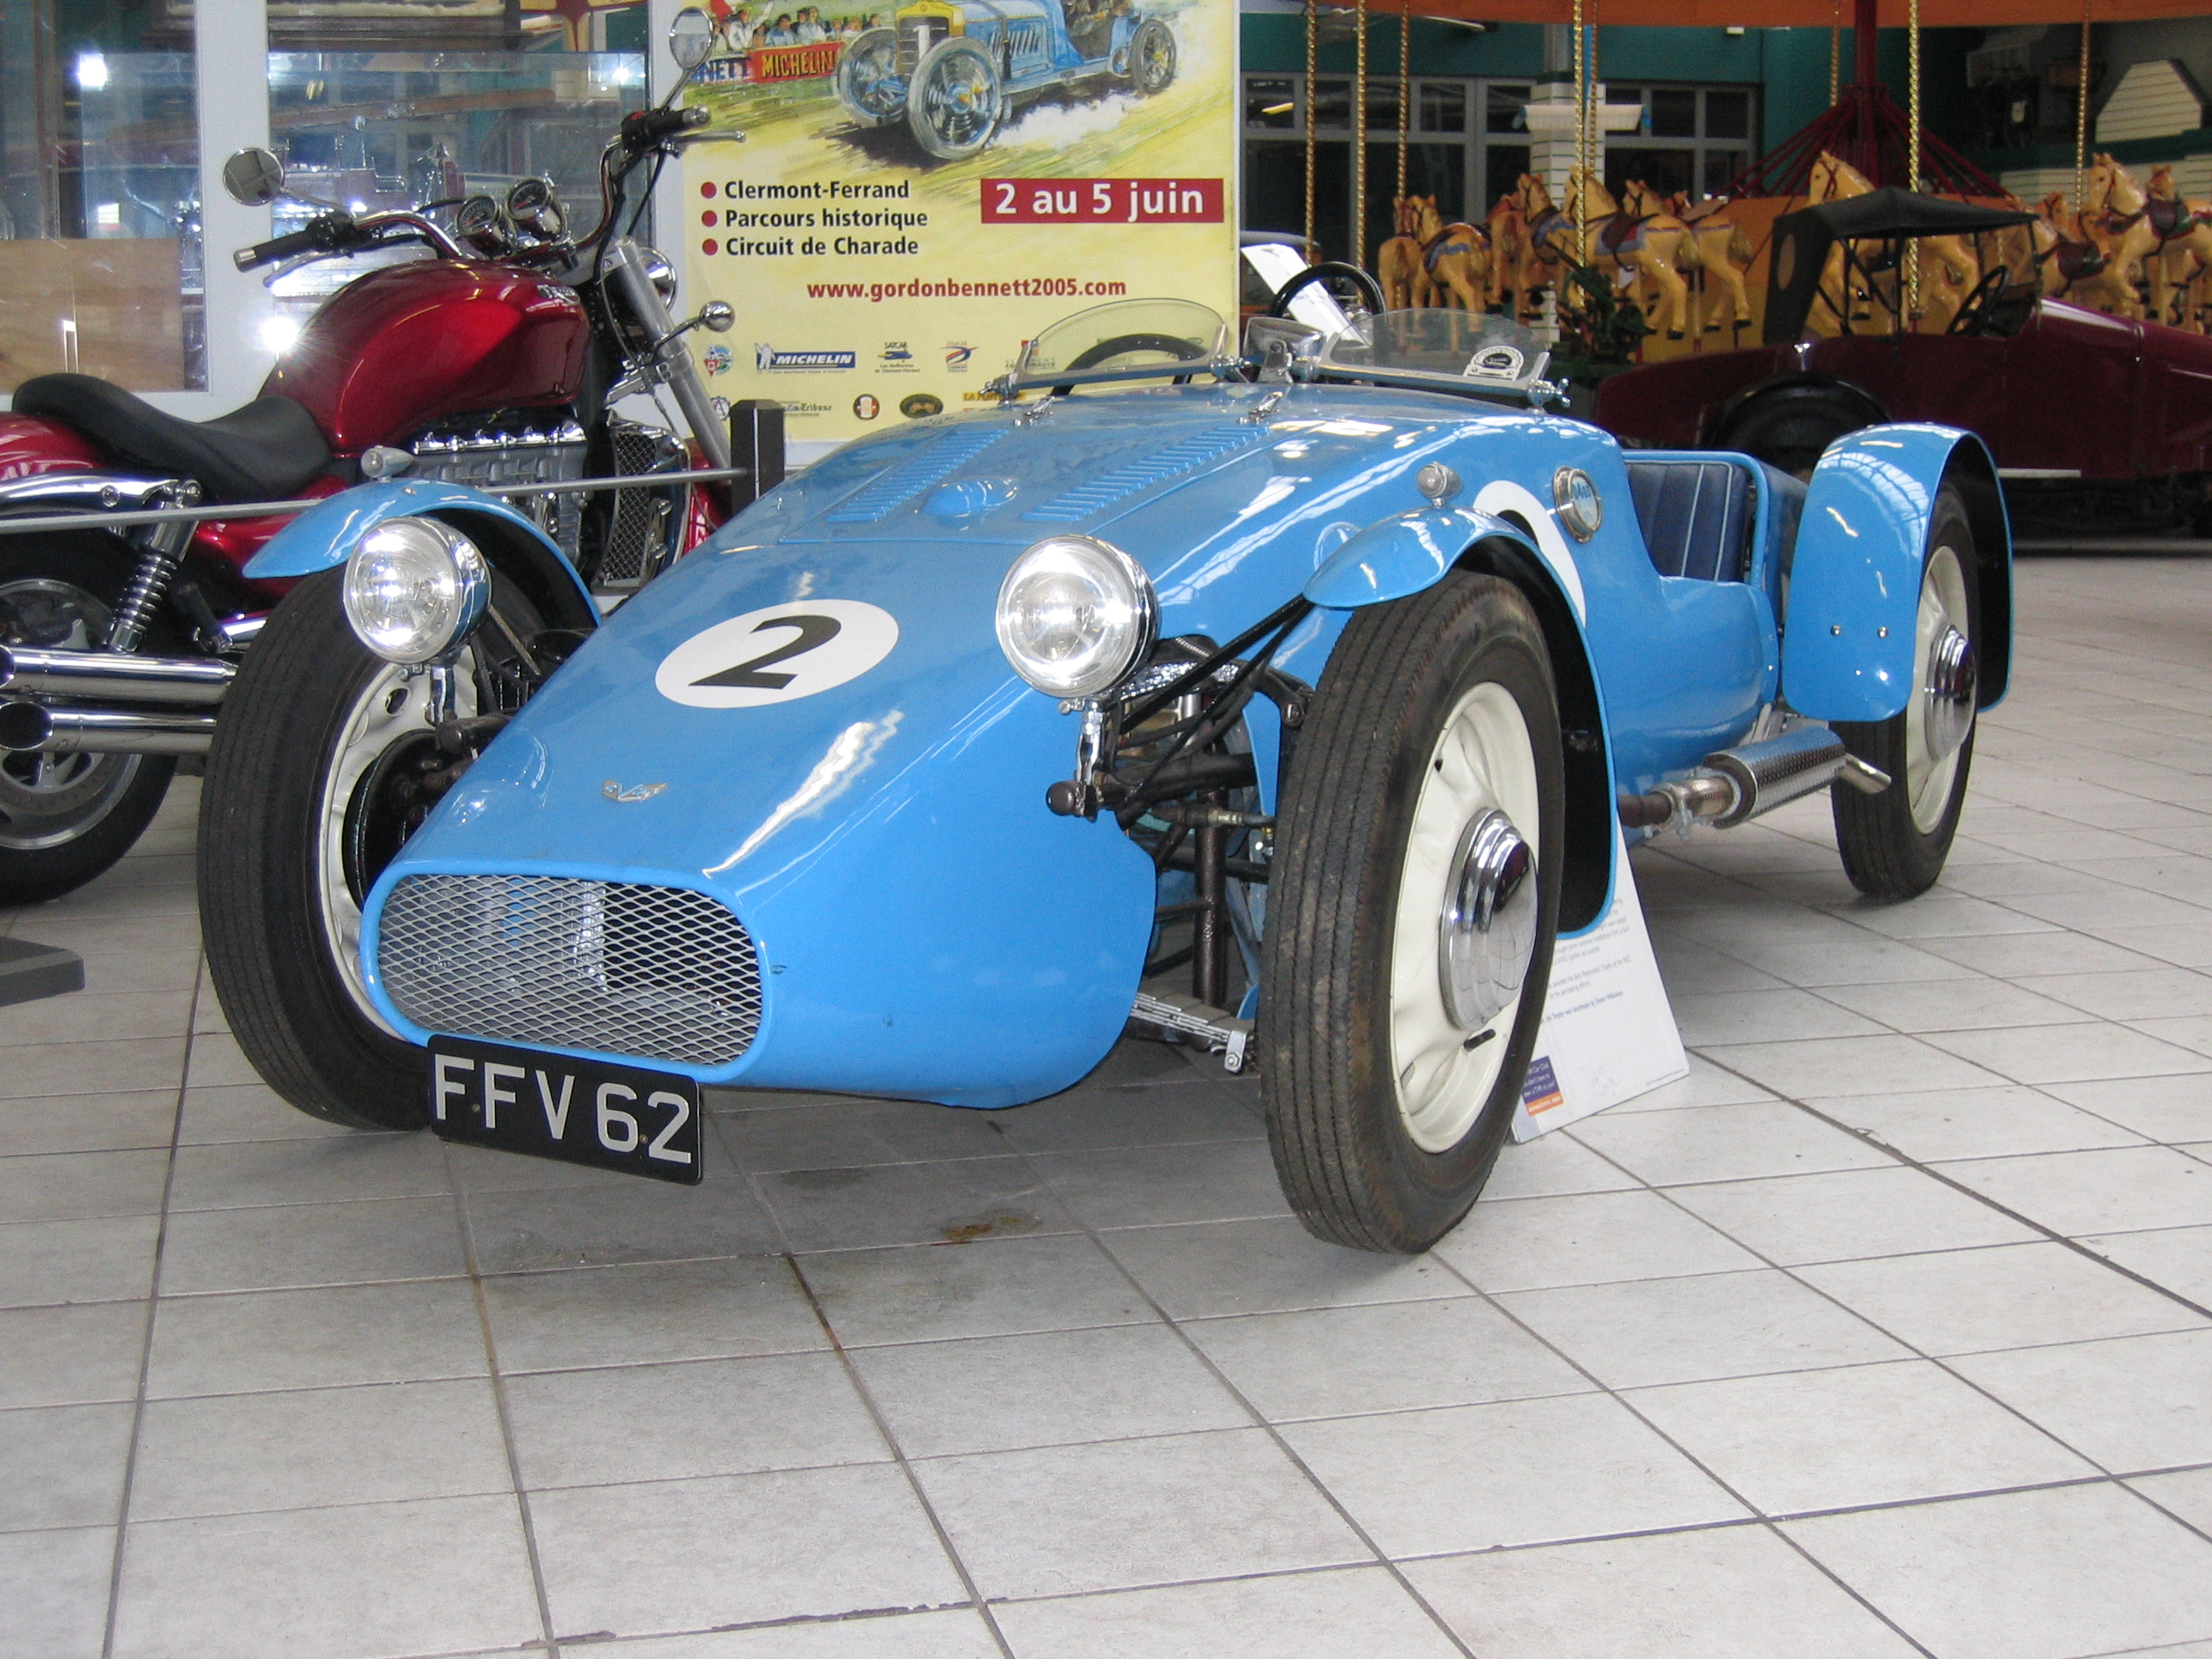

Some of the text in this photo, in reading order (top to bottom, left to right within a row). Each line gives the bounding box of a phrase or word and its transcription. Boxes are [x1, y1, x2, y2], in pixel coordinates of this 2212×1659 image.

[760, 49, 835, 79] MICHELIN
[725, 179, 910, 200] Clermont-Ferrand
[995, 182, 1017, 214] 2
[1032, 189, 1078, 215] au
[1092, 183, 1113, 215] 5
[1126, 182, 1203, 222] juin
[725, 207, 928, 231] Parcours historique
[725, 236, 919, 256] Circuit de Charade
[807, 277, 1126, 303] www.gordonbennett2005.com
[775, 354, 853, 365] MICHELIN
[687, 614, 842, 690] 2
[434, 1053, 692, 1164] FFV 62
